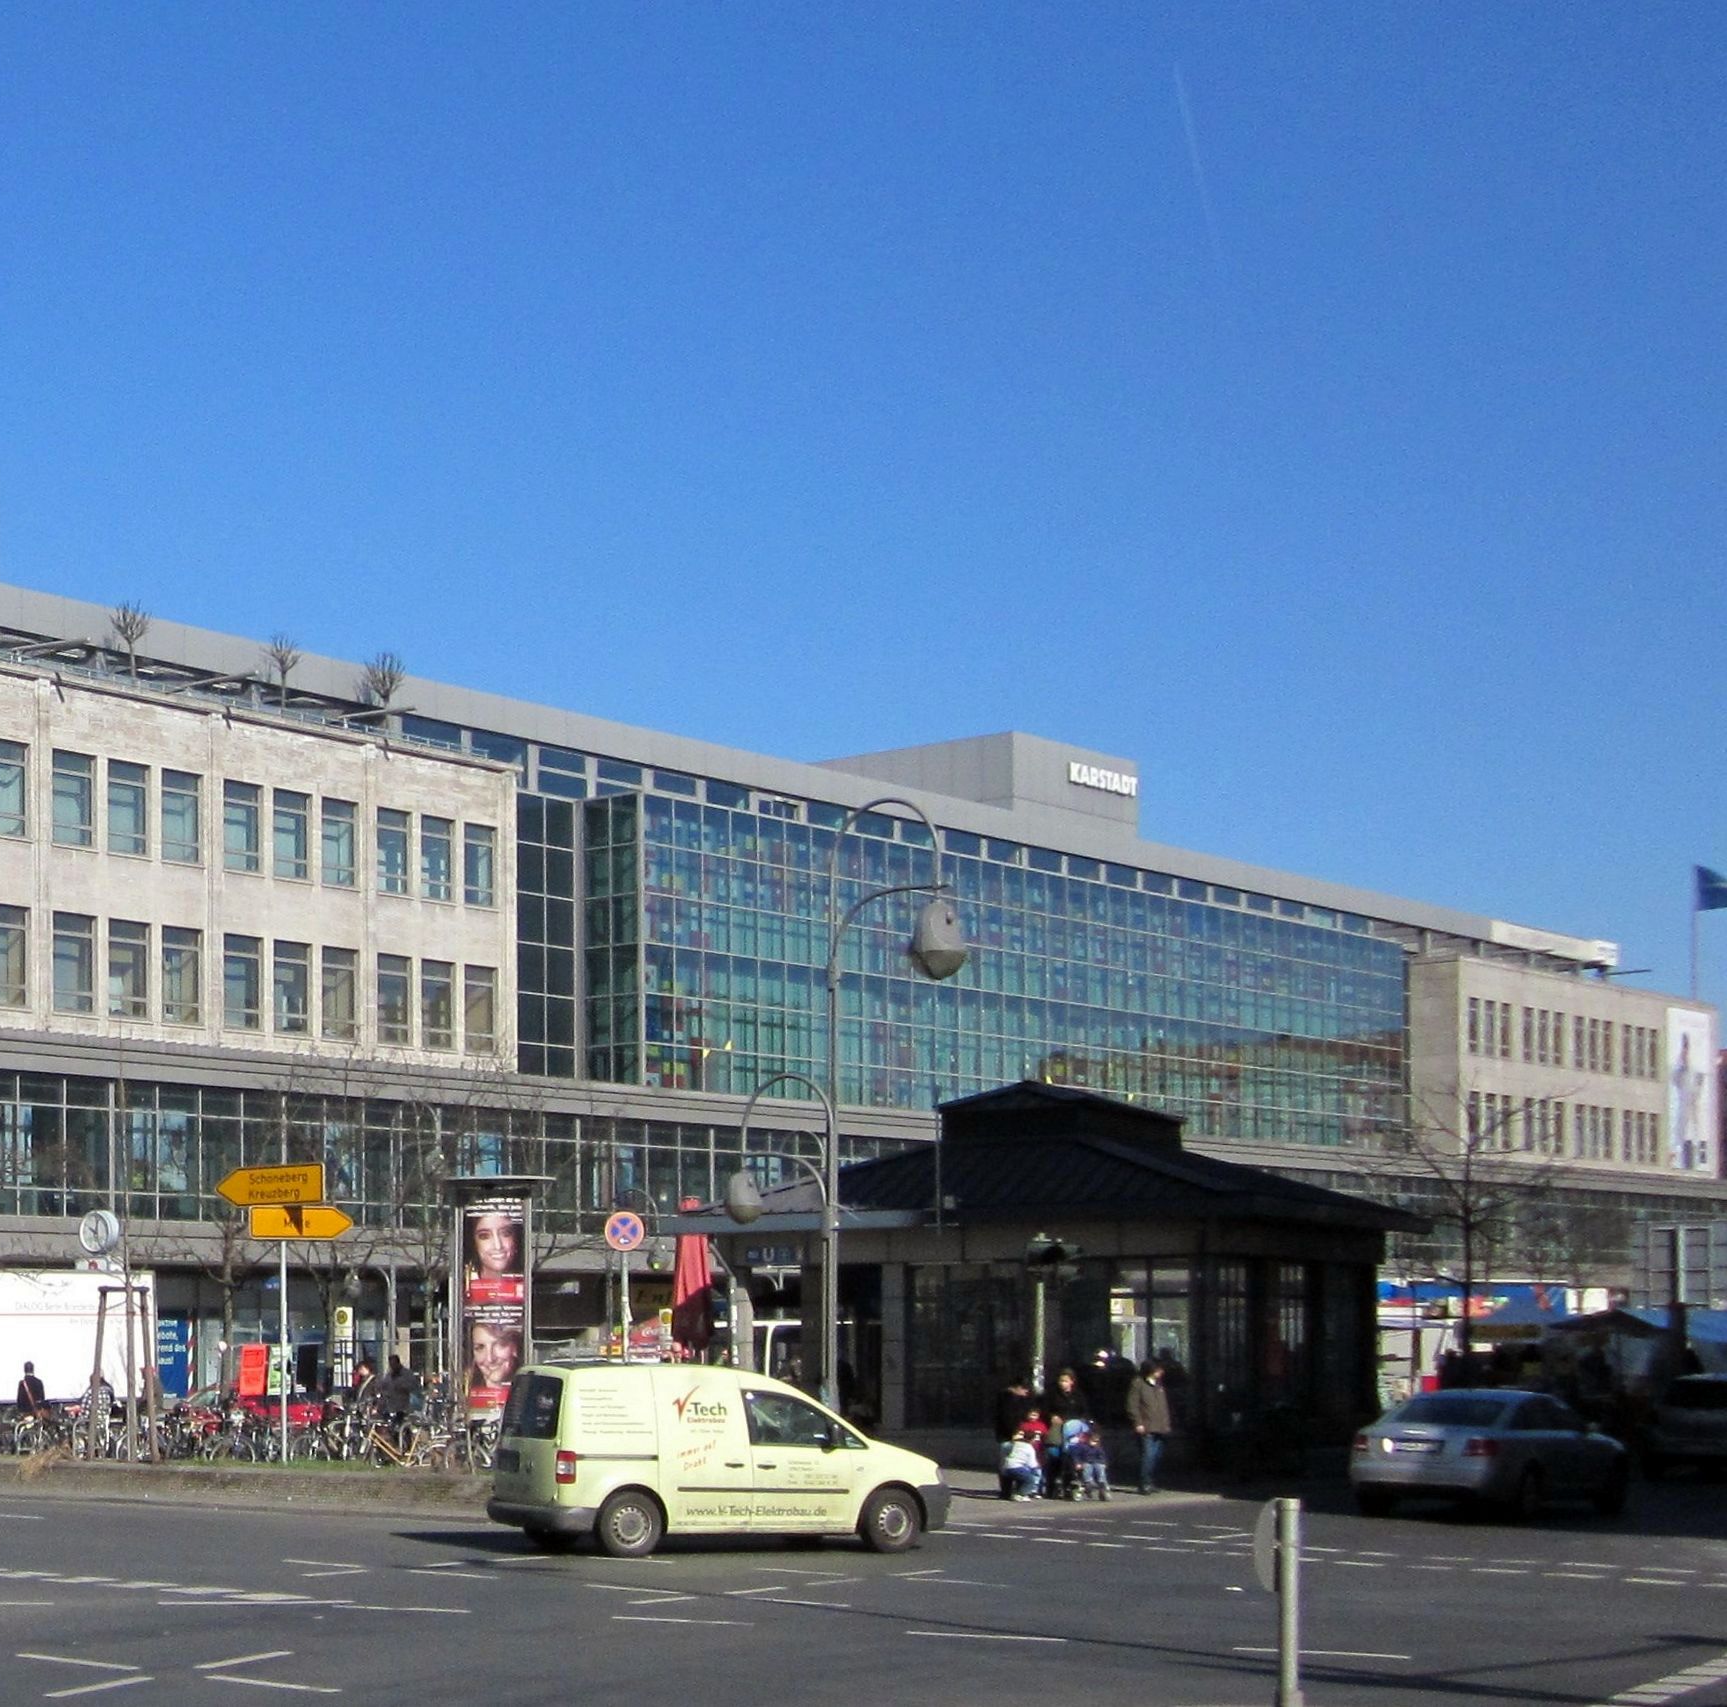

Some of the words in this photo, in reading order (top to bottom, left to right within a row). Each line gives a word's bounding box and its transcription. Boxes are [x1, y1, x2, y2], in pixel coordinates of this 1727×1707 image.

[1070, 761, 1138, 797] KARSTADT
[248, 1187, 301, 1200] Kreuzberg
[672, 1385, 728, 1424] V-Tech
